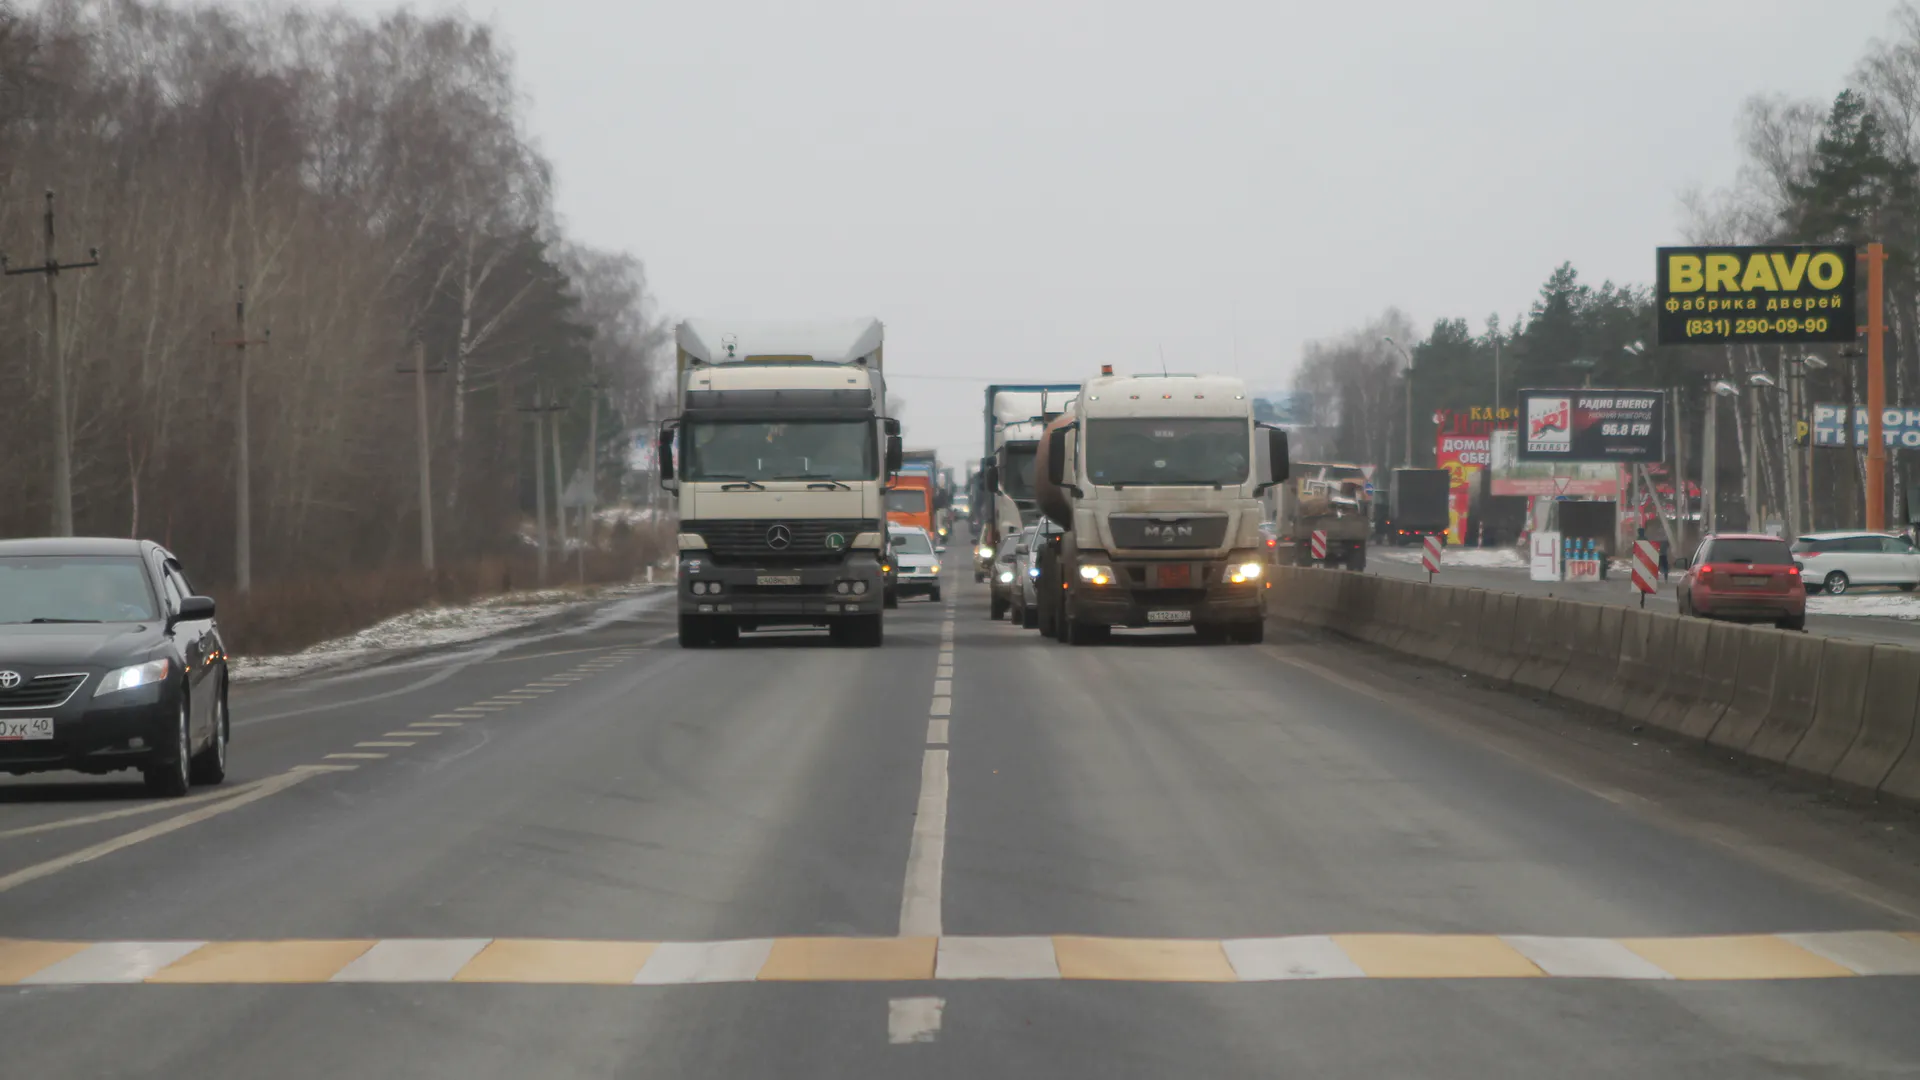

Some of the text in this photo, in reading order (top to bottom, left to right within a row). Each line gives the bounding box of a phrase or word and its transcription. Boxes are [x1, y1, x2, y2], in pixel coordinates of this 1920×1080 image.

[1668, 252, 1844, 293] BRAVO
[1665, 295, 1841, 313] фабрика дверей
[1686, 318, 1828, 337] (831) 290-09-90
[1579, 399, 1656, 410] РАДИО ENERGY
[1601, 424, 1650, 436] 96.8 FM
[1443, 439, 1490, 452] ДОМА
[1529, 443, 1568, 451] ENERGY
[1144, 526, 1193, 537] MAN
[33, 719, 49, 731] 40
